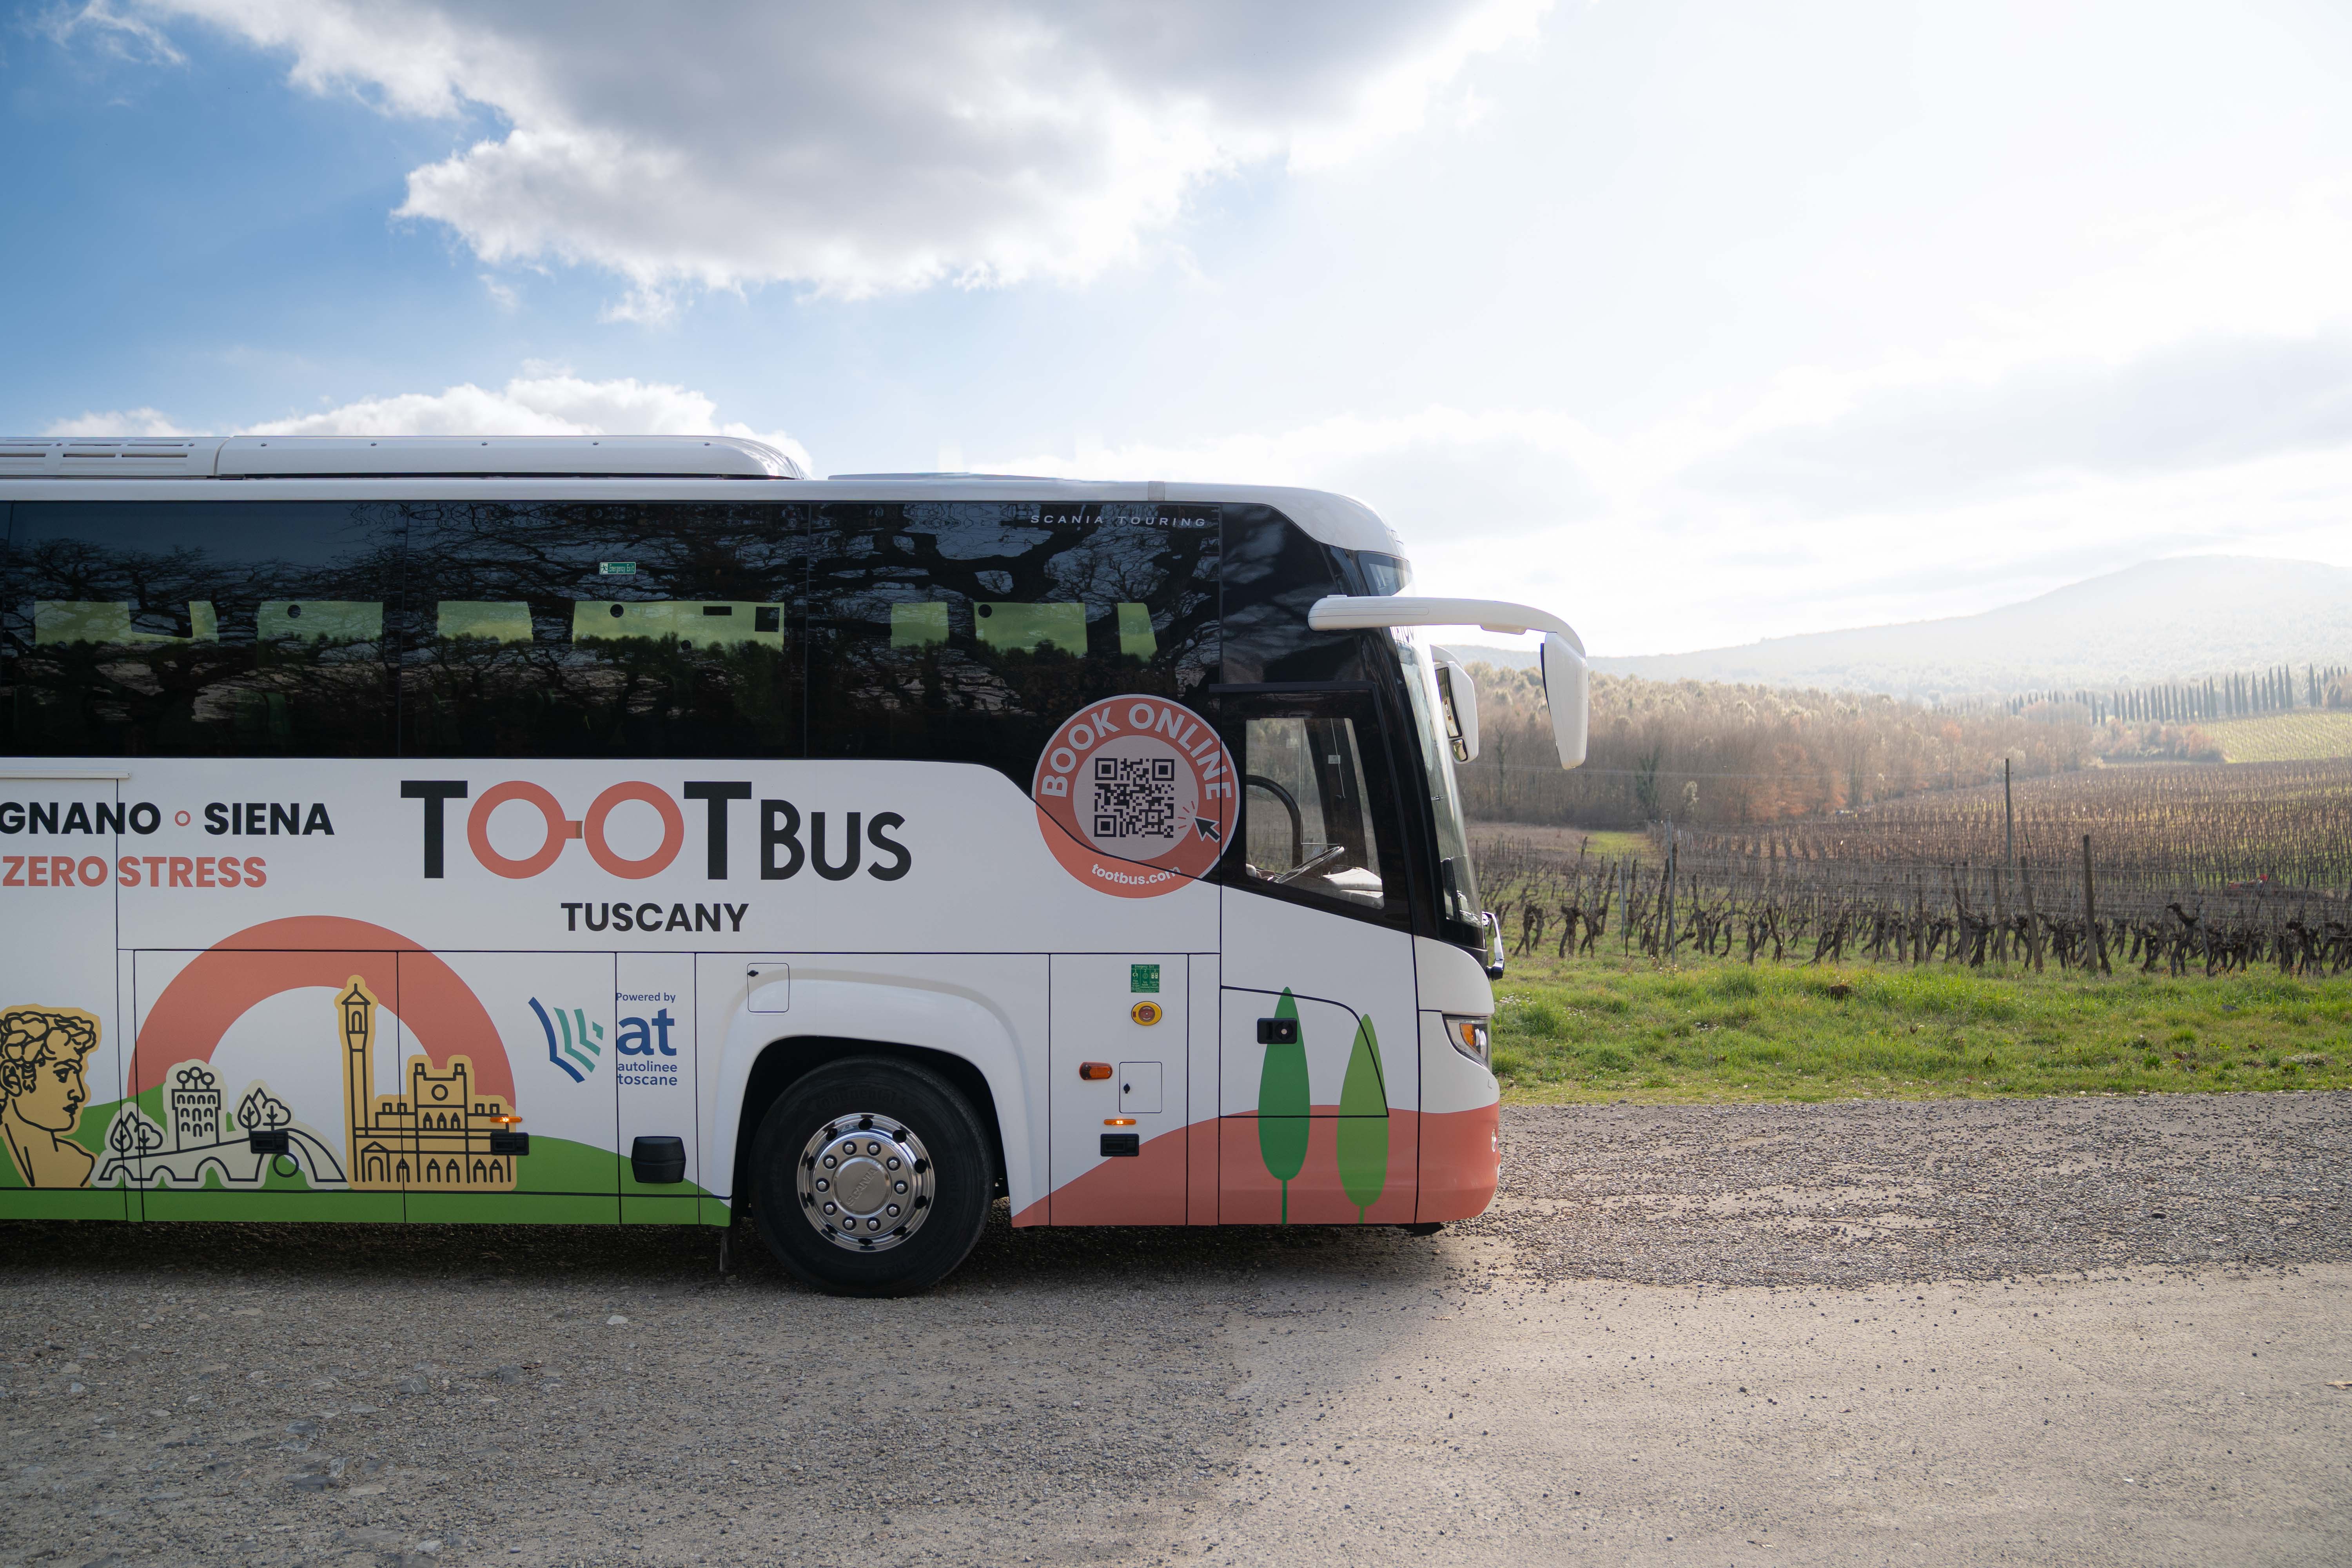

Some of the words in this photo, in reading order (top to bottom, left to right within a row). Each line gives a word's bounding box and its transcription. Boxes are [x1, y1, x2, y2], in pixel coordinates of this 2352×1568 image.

[1031, 515, 1103, 524] SCANIA
[1118, 516, 1205, 526] TOURING
[609, 564, 625, 573] Emergency
[1041, 706, 1120, 797] BOOK
[1129, 703, 1232, 800] ONLINE
[204, 802, 335, 835] SIENA
[3, 856, 108, 887] ZERO
[118, 856, 267, 887] STRESS
[1092, 864, 1181, 885] tootbus.com
[561, 902, 749, 932] TUSCANY
[616, 992, 661, 1001] Powered
[663, 992, 676, 1003] by
[617, 1008, 677, 1056] at
[617, 1060, 677, 1072] autolinee
[617, 1074, 677, 1085] toscane
[846, 1167, 878, 1206] SCANIA
